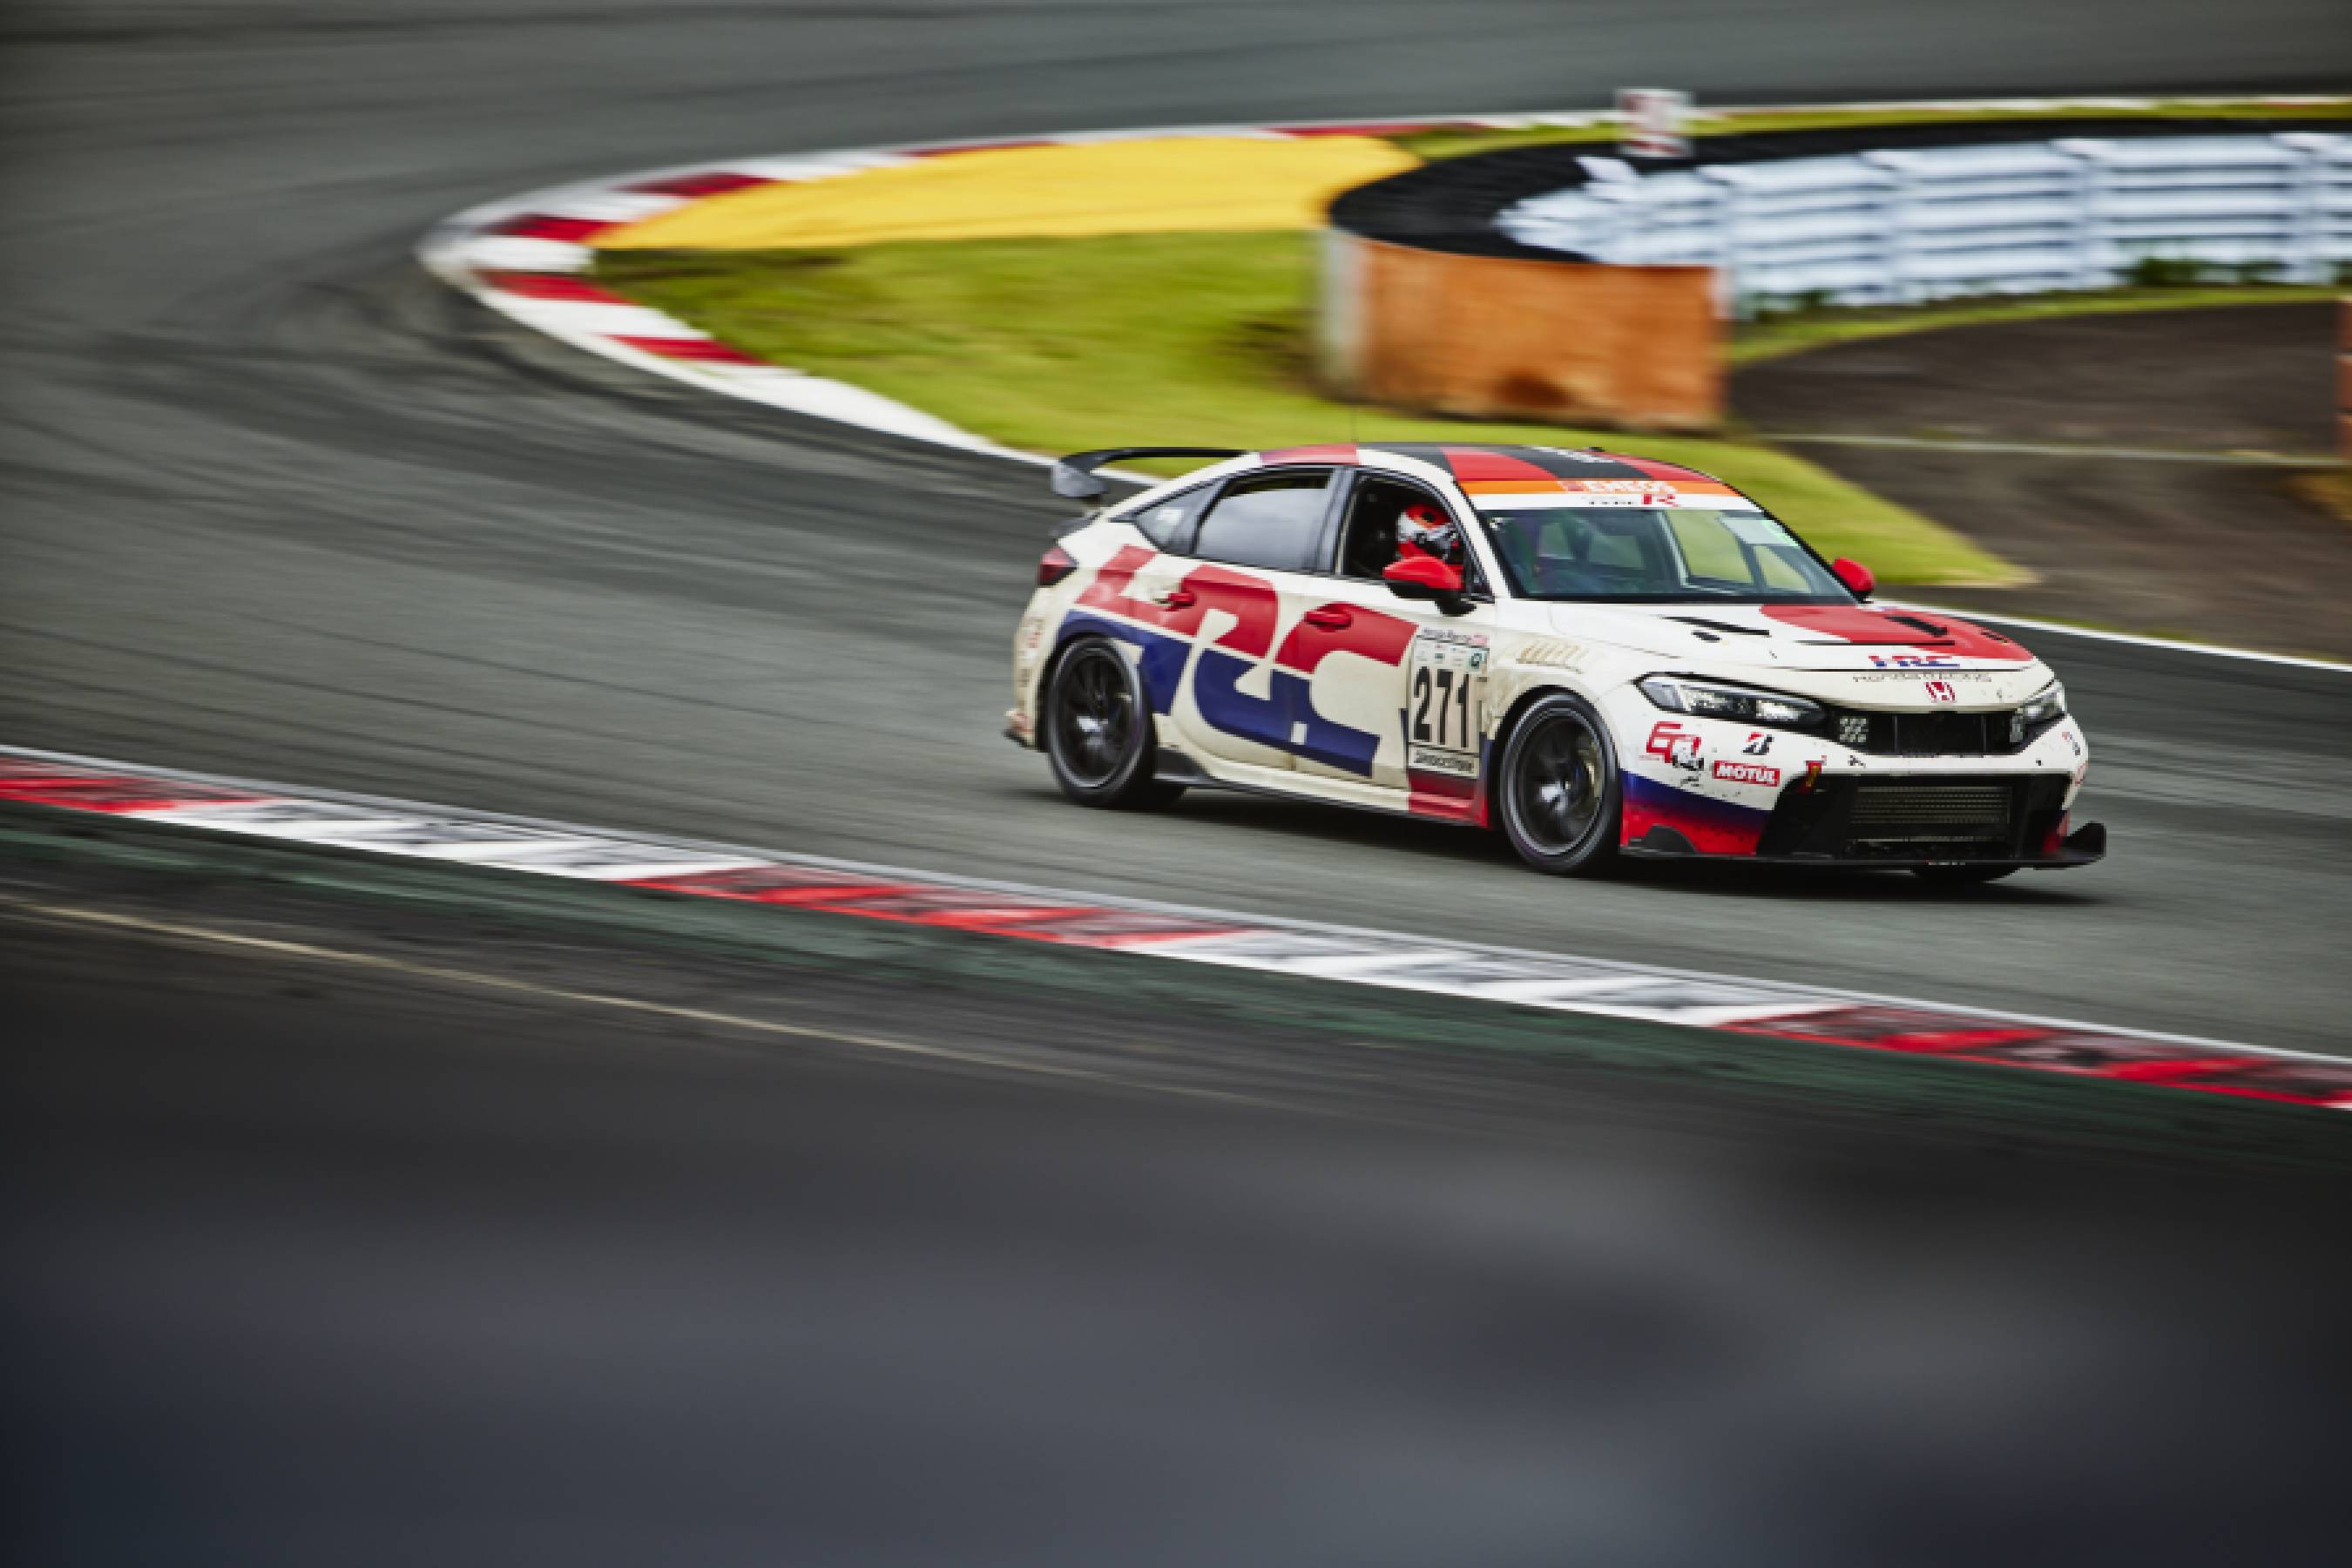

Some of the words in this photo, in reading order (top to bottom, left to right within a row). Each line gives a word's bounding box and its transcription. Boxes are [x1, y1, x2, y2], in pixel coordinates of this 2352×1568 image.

[1868, 655, 1960, 667] HRC
[1413, 666, 1470, 748] 271
[1715, 764, 1775, 783] MOTUL
